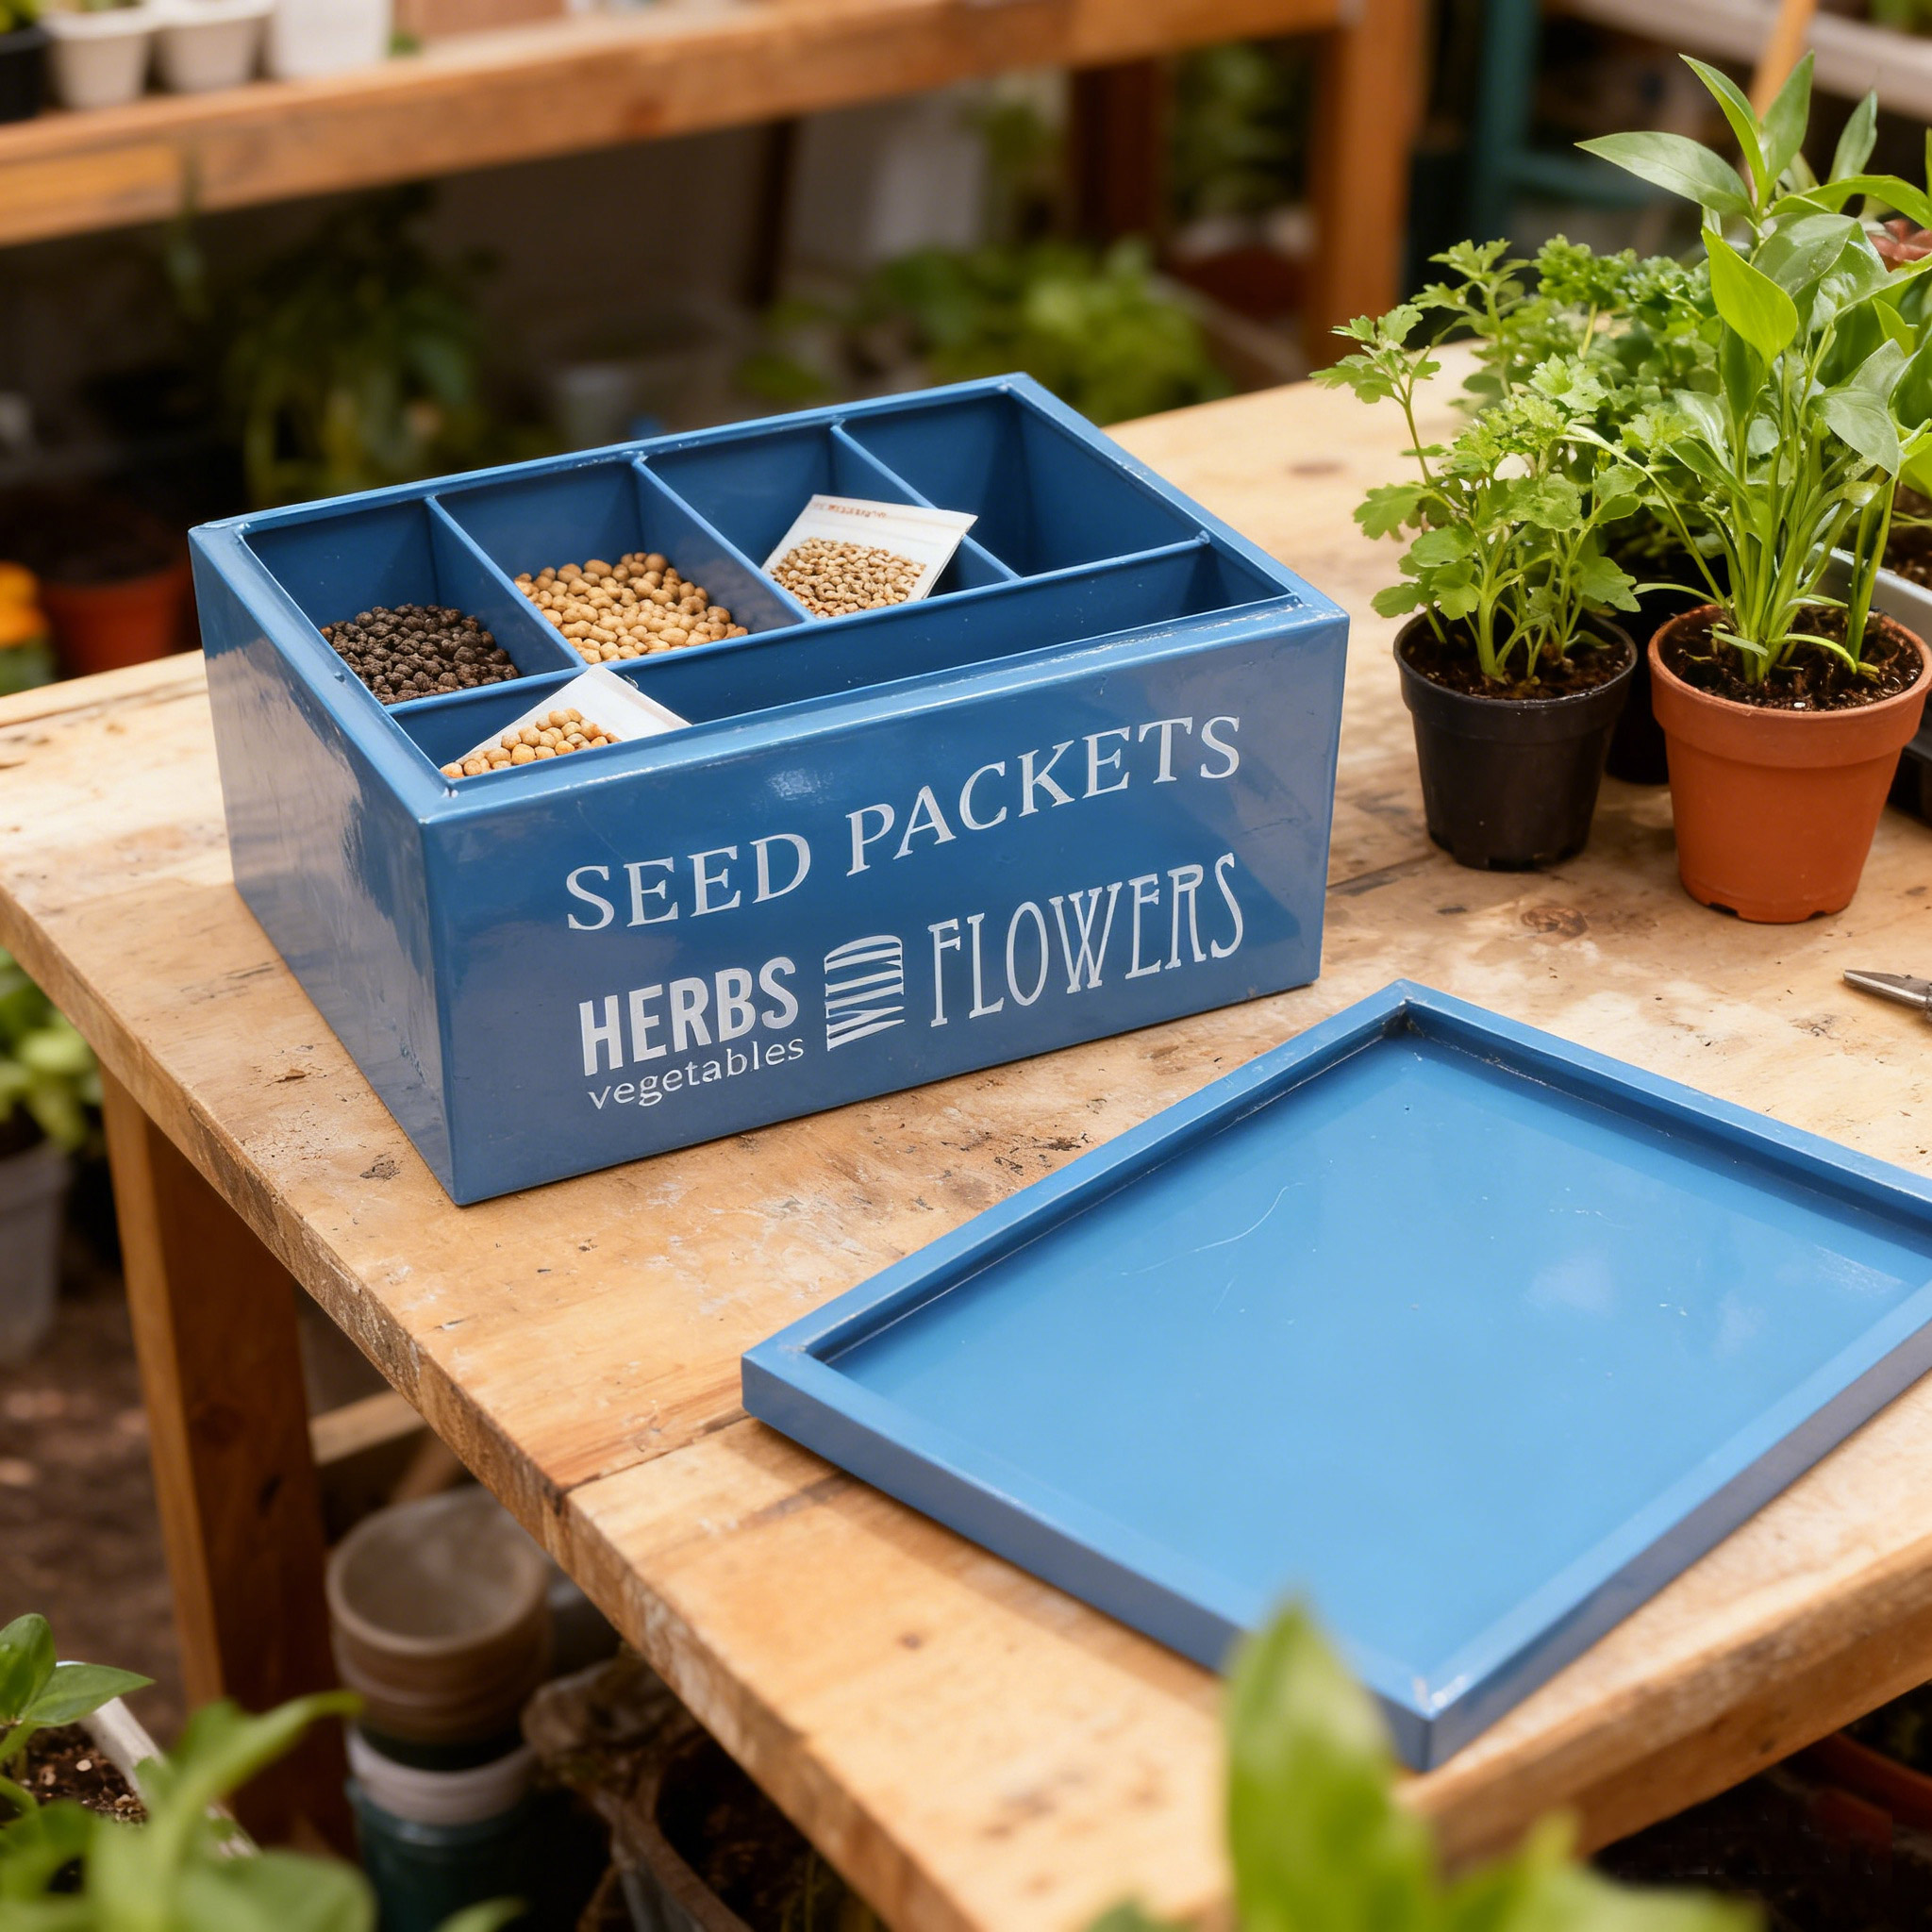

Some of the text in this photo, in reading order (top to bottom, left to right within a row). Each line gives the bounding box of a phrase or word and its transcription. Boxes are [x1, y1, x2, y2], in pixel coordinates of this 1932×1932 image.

[566, 715, 1241, 931] SEED PACKETS
[824, 934, 906, 1052] WILD
[927, 852, 1244, 1028] FLOWERS
[578, 957, 799, 1077] HERBS
[587, 1037, 805, 1110] vegetables
